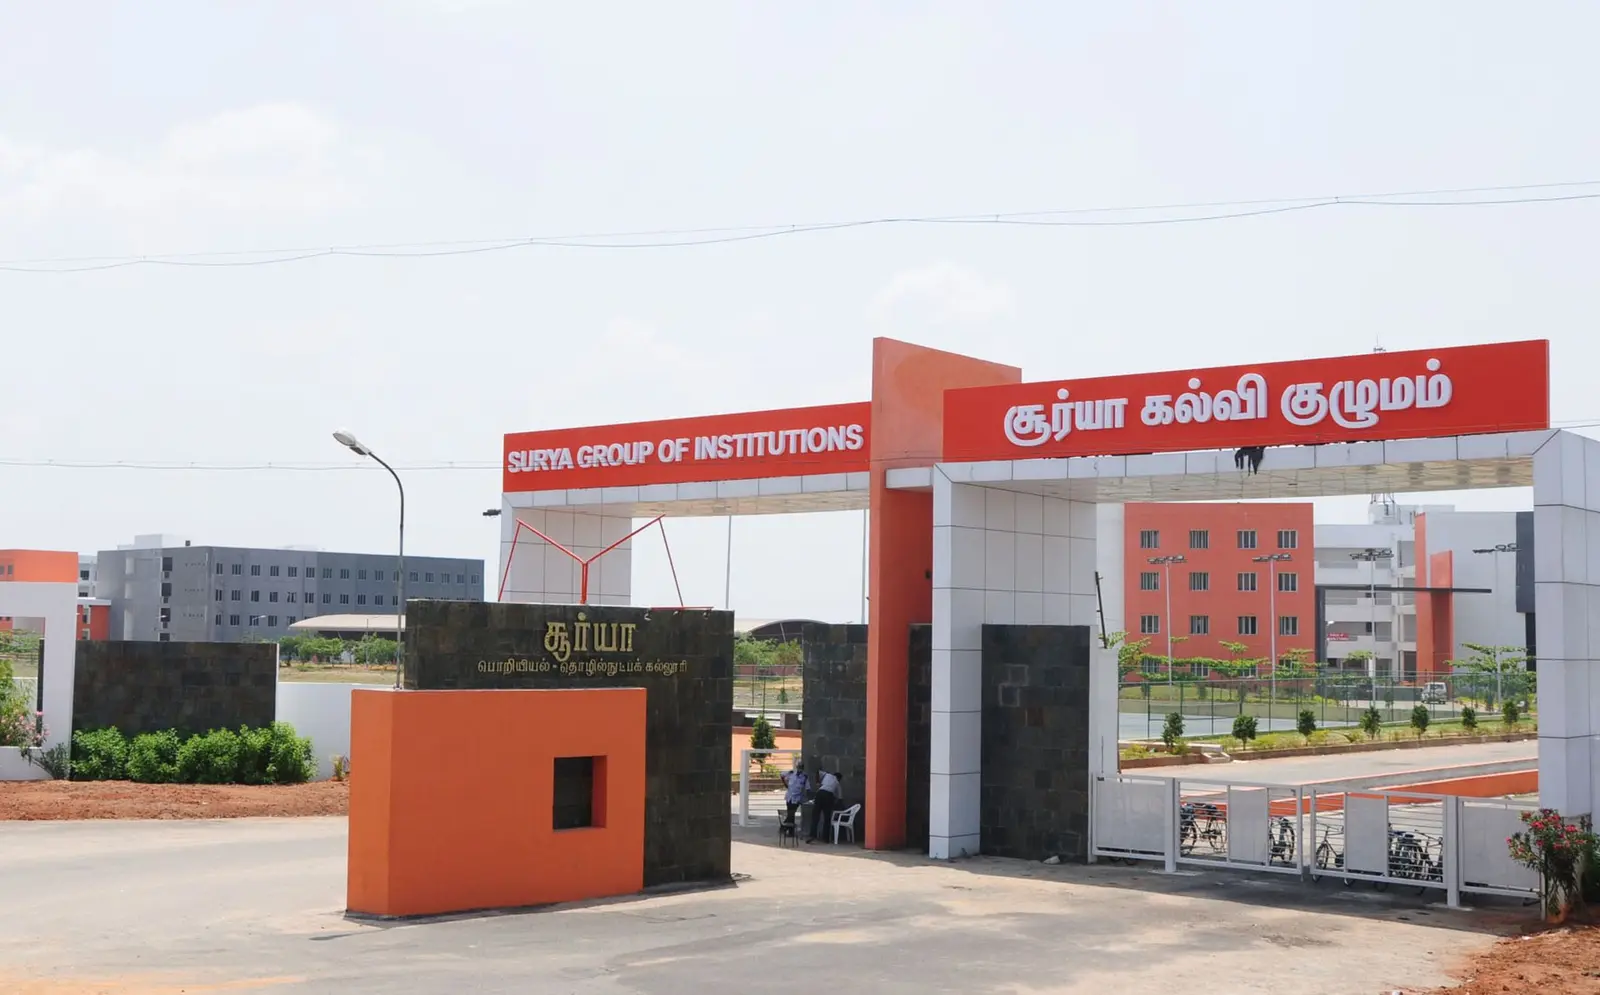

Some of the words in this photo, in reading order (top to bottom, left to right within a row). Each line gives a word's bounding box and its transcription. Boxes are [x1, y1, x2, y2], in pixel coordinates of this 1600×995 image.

[1004, 388, 1128, 446] சூர்யா
[1140, 373, 1267, 426] கல்வி
[1281, 358, 1452, 428] குழுமம்
[508, 448, 574, 473] SURYA
[577, 442, 654, 468] GROUP
[658, 438, 691, 462] OF
[694, 424, 864, 460] INSTITUTIONS
[544, 612, 636, 662] சூர்யா
[477, 658, 550, 676] பொறியியல்
[560, 658, 643, 676] தொழில்நுட்பக்
[645, 658, 688, 676] கல்லூரி
